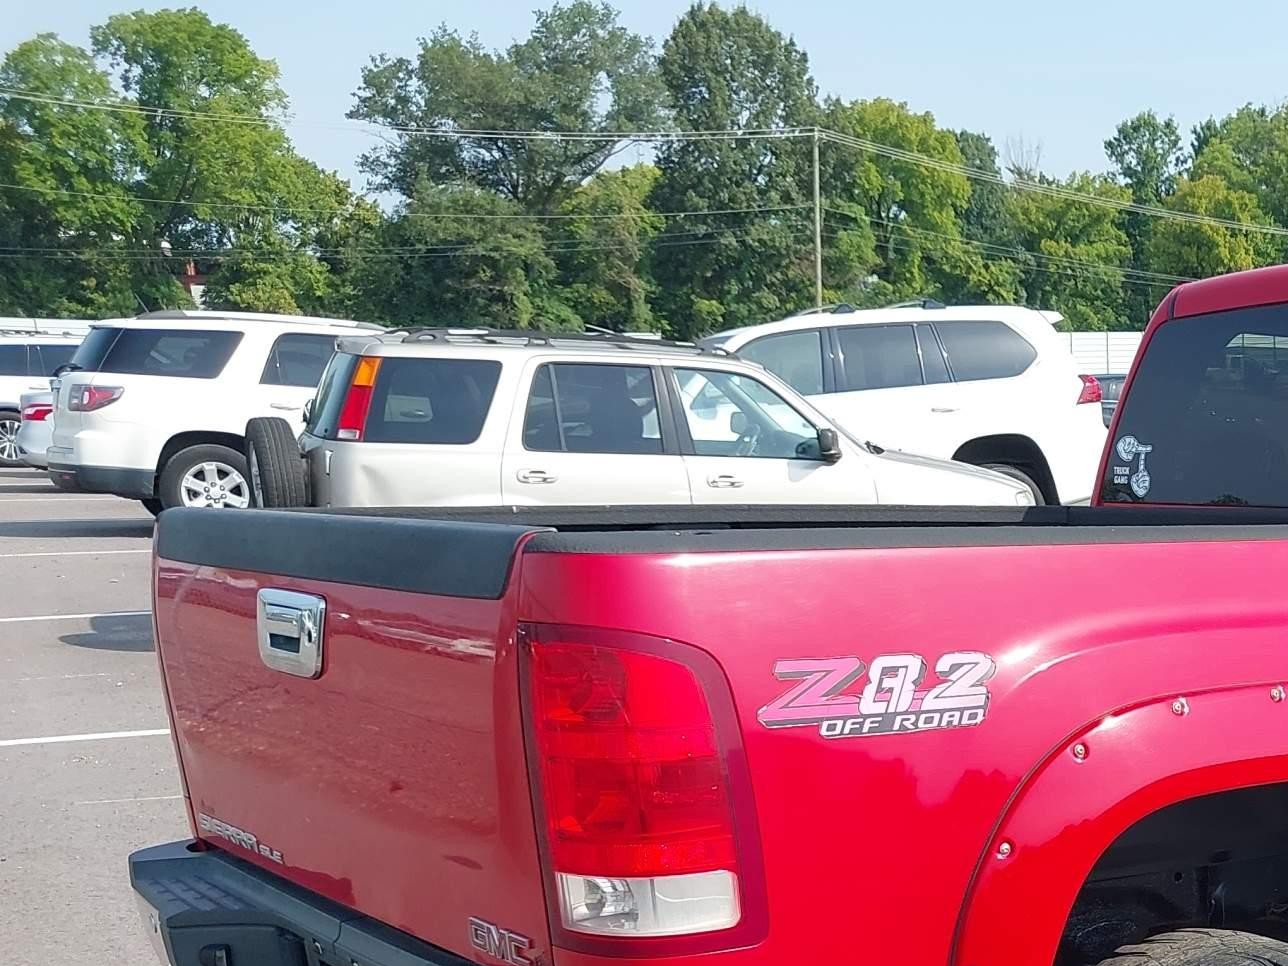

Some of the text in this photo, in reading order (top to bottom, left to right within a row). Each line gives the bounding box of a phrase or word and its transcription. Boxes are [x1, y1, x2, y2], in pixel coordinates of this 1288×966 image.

[1113, 466, 1130, 475] TRUCK
[1113, 475, 1129, 484] GANG
[821, 708, 985, 737] OFF ROAD
[199, 812, 284, 865] SIERRA SLE
